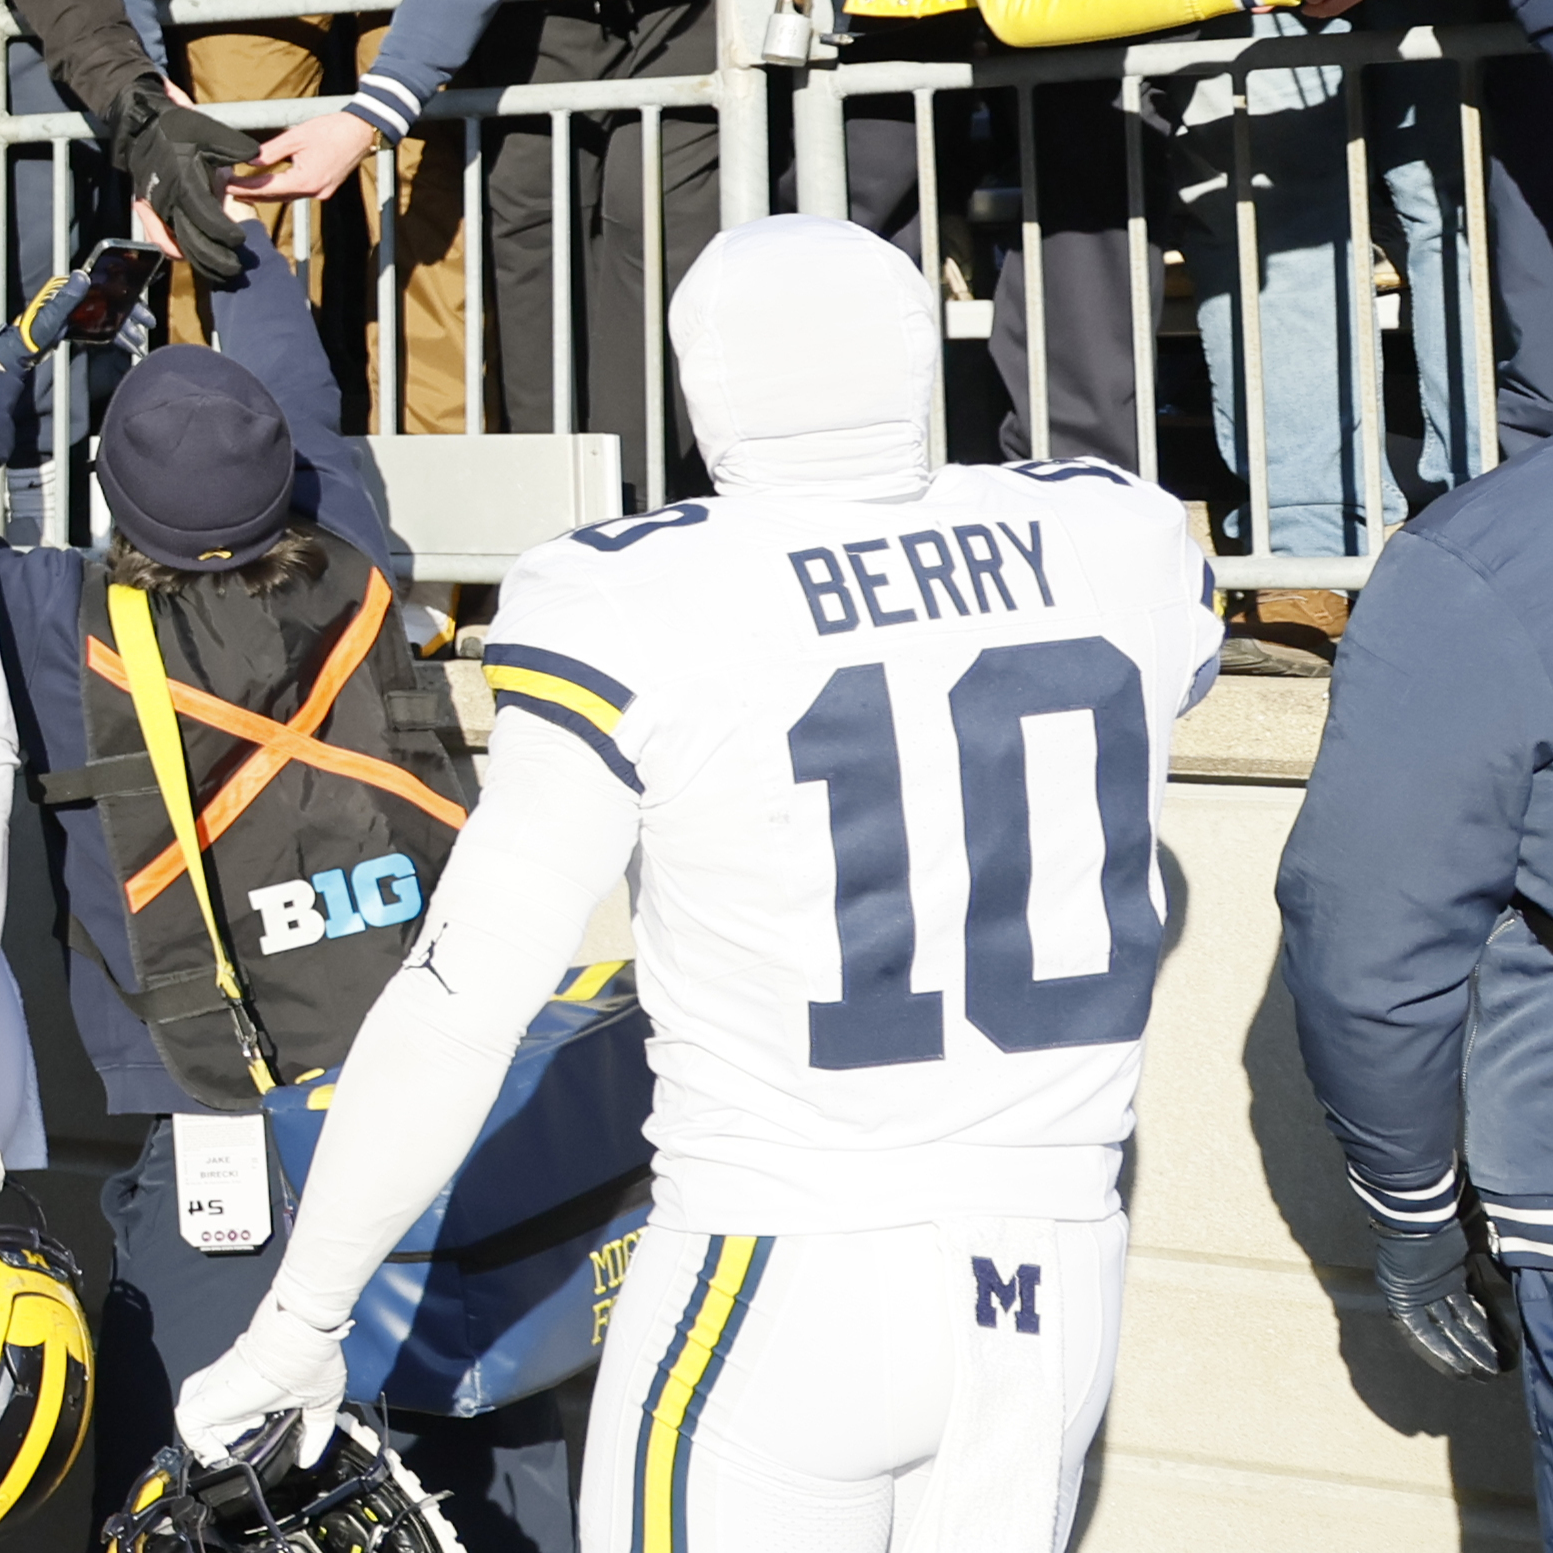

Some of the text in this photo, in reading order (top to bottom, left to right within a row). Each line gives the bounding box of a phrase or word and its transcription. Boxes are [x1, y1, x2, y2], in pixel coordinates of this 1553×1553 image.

[787, 519, 1056, 637] BERRY
[785, 635, 1166, 1071] 10
[199, 1170, 239, 1179] BIRECKI
[206, 1156, 231, 1165] JAKE
[970, 1255, 1042, 1335] M
